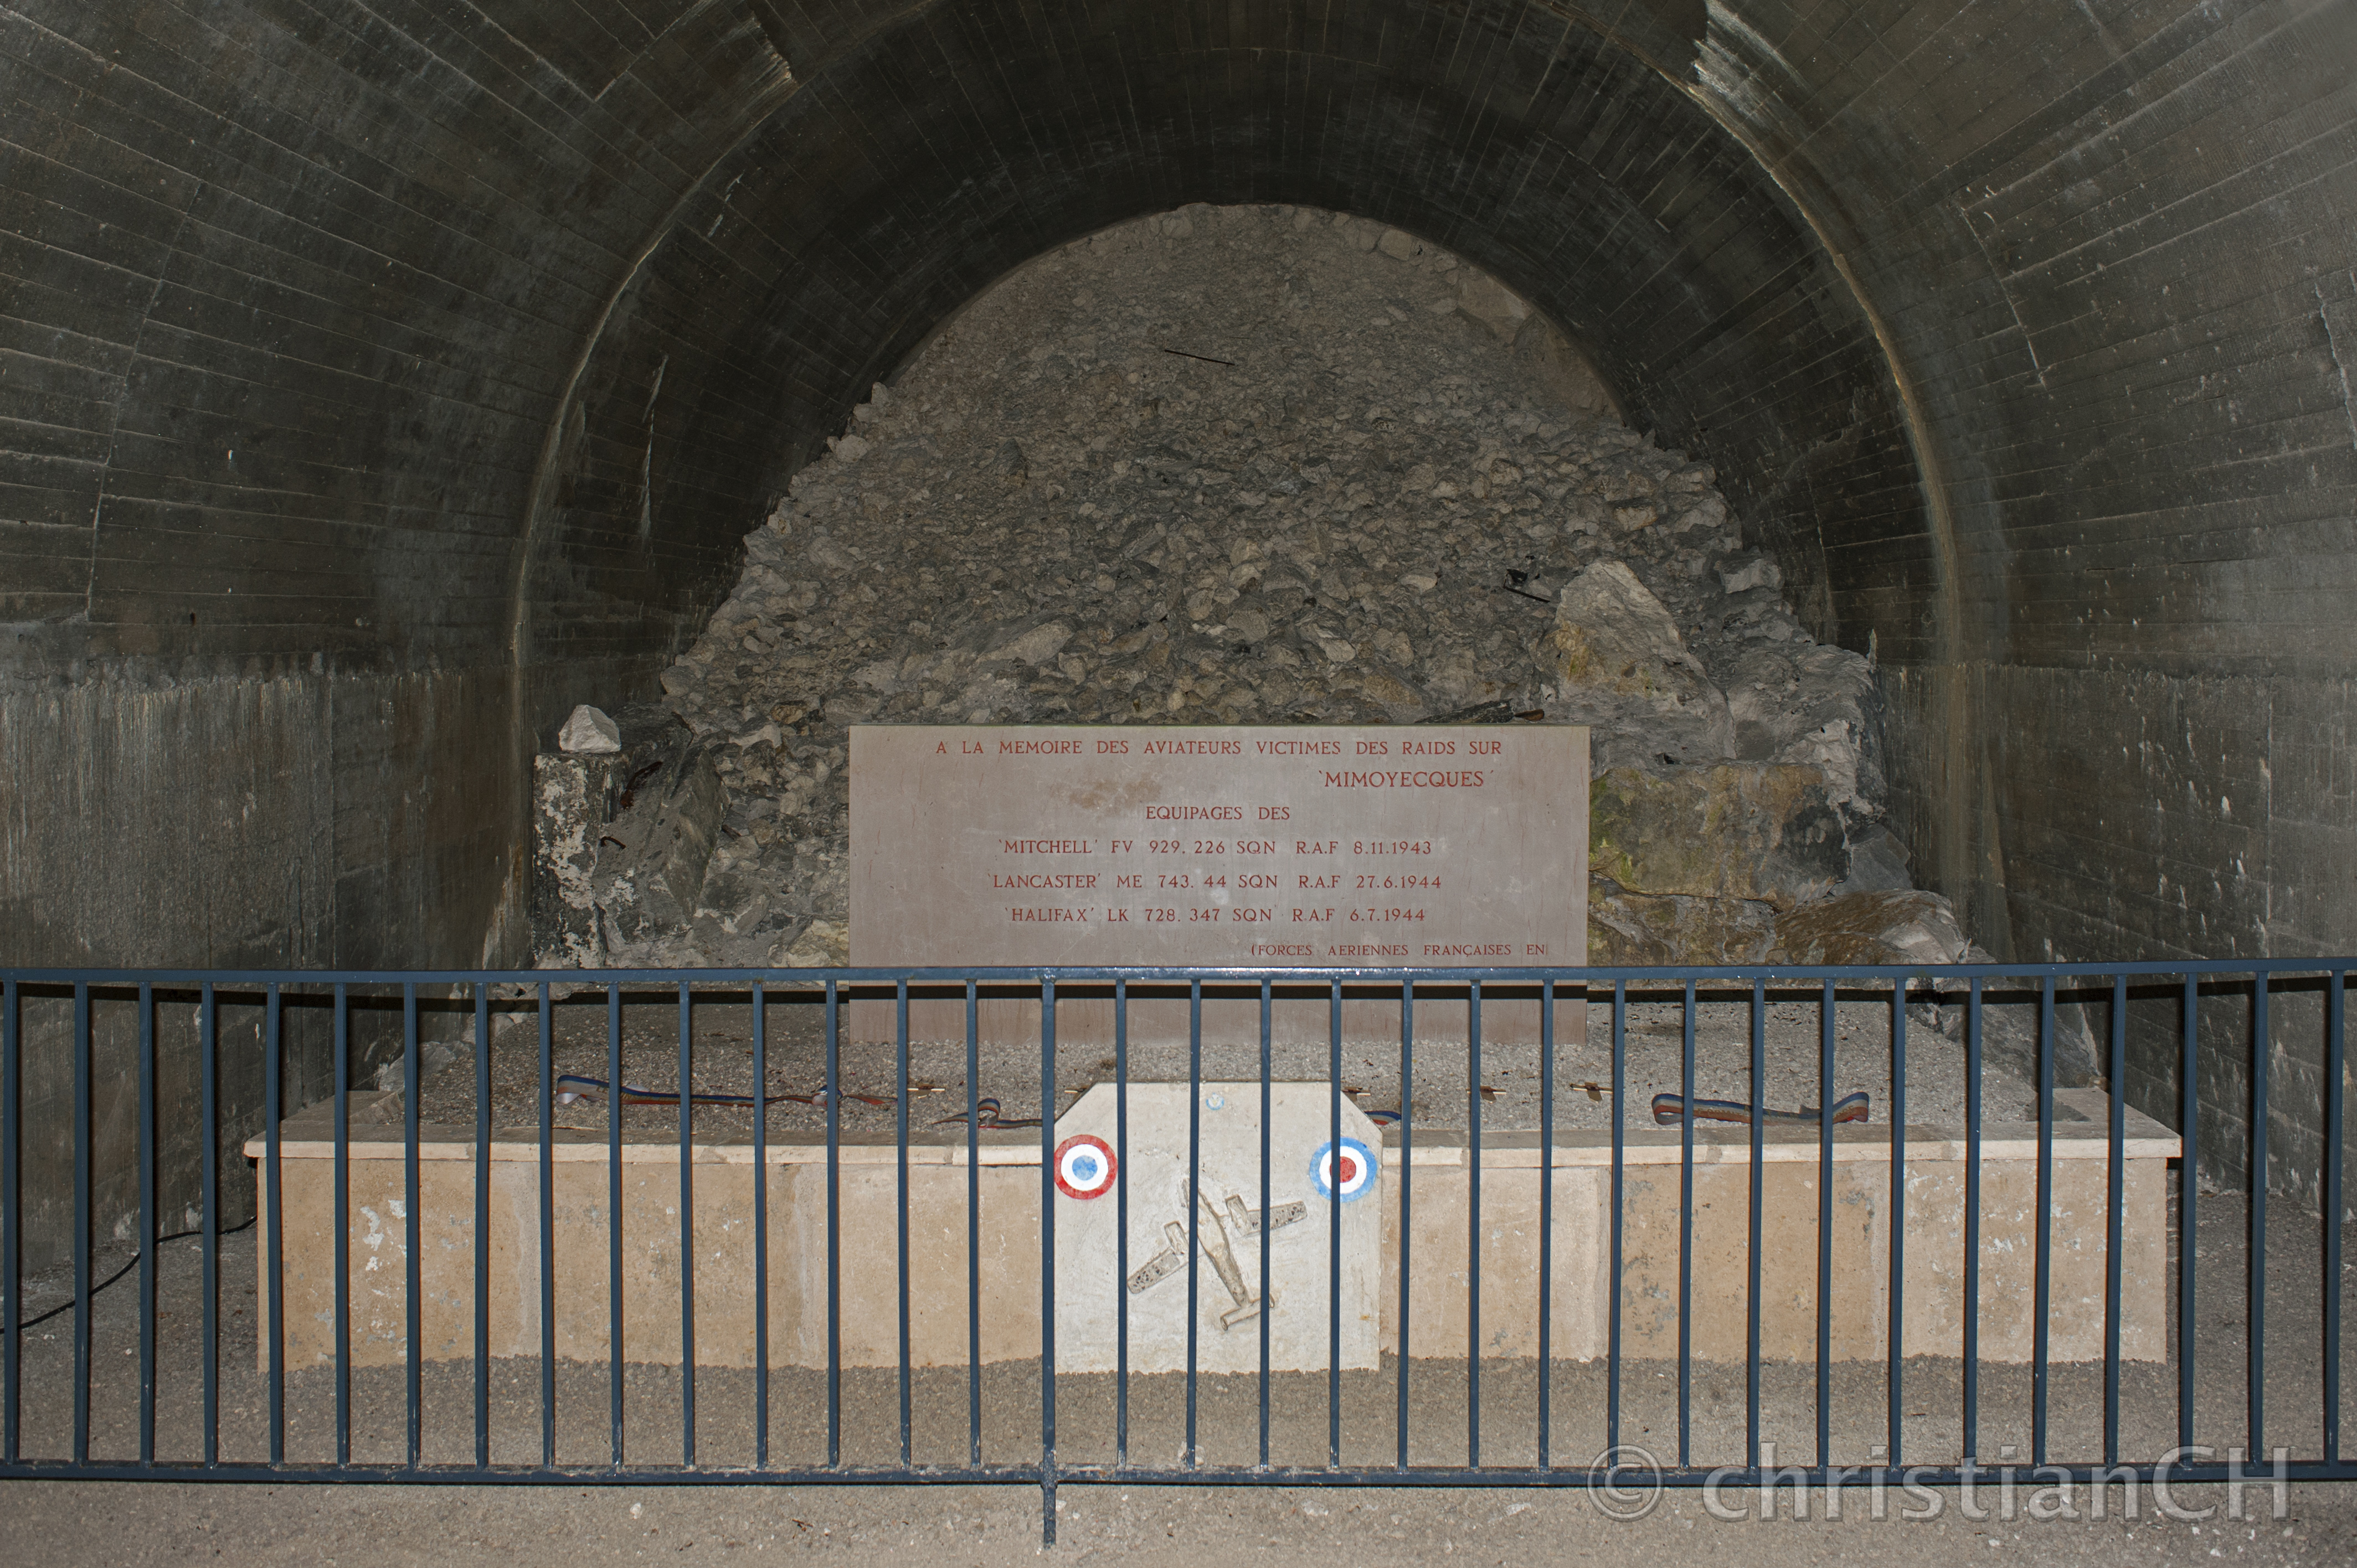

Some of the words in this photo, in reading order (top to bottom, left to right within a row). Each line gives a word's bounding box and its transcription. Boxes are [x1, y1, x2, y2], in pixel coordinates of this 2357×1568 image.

[936, 741, 947, 754] A
[962, 740, 984, 754] LA
[999, 740, 1082, 755] MEMOIRE
[1097, 740, 1129, 755] DES
[1143, 740, 1241, 755] AVIATEURS
[1256, 740, 1341, 755] VICTIMES
[1356, 741, 1388, 755] DES
[1402, 740, 1455, 755] RAIDS
[1469, 740, 1502, 755] SUR
[1146, 806, 1243, 821] EQUIPAGES
[1258, 806, 1290, 821] DES
[1111, 839, 1133, 854] FV
[1237, 840, 1275, 855] SQN
[1116, 874, 1142, 889] ME
[1238, 874, 1278, 889] SQN
[1108, 908, 1129, 922] LK
[1232, 908, 1272, 922] SQN
[1250, 944, 1313, 956] (FORCES
[1328, 944, 1408, 956] AERIENNES
[1424, 943, 1511, 957] FRANÇAISES
[1526, 943, 1545, 955] EN
